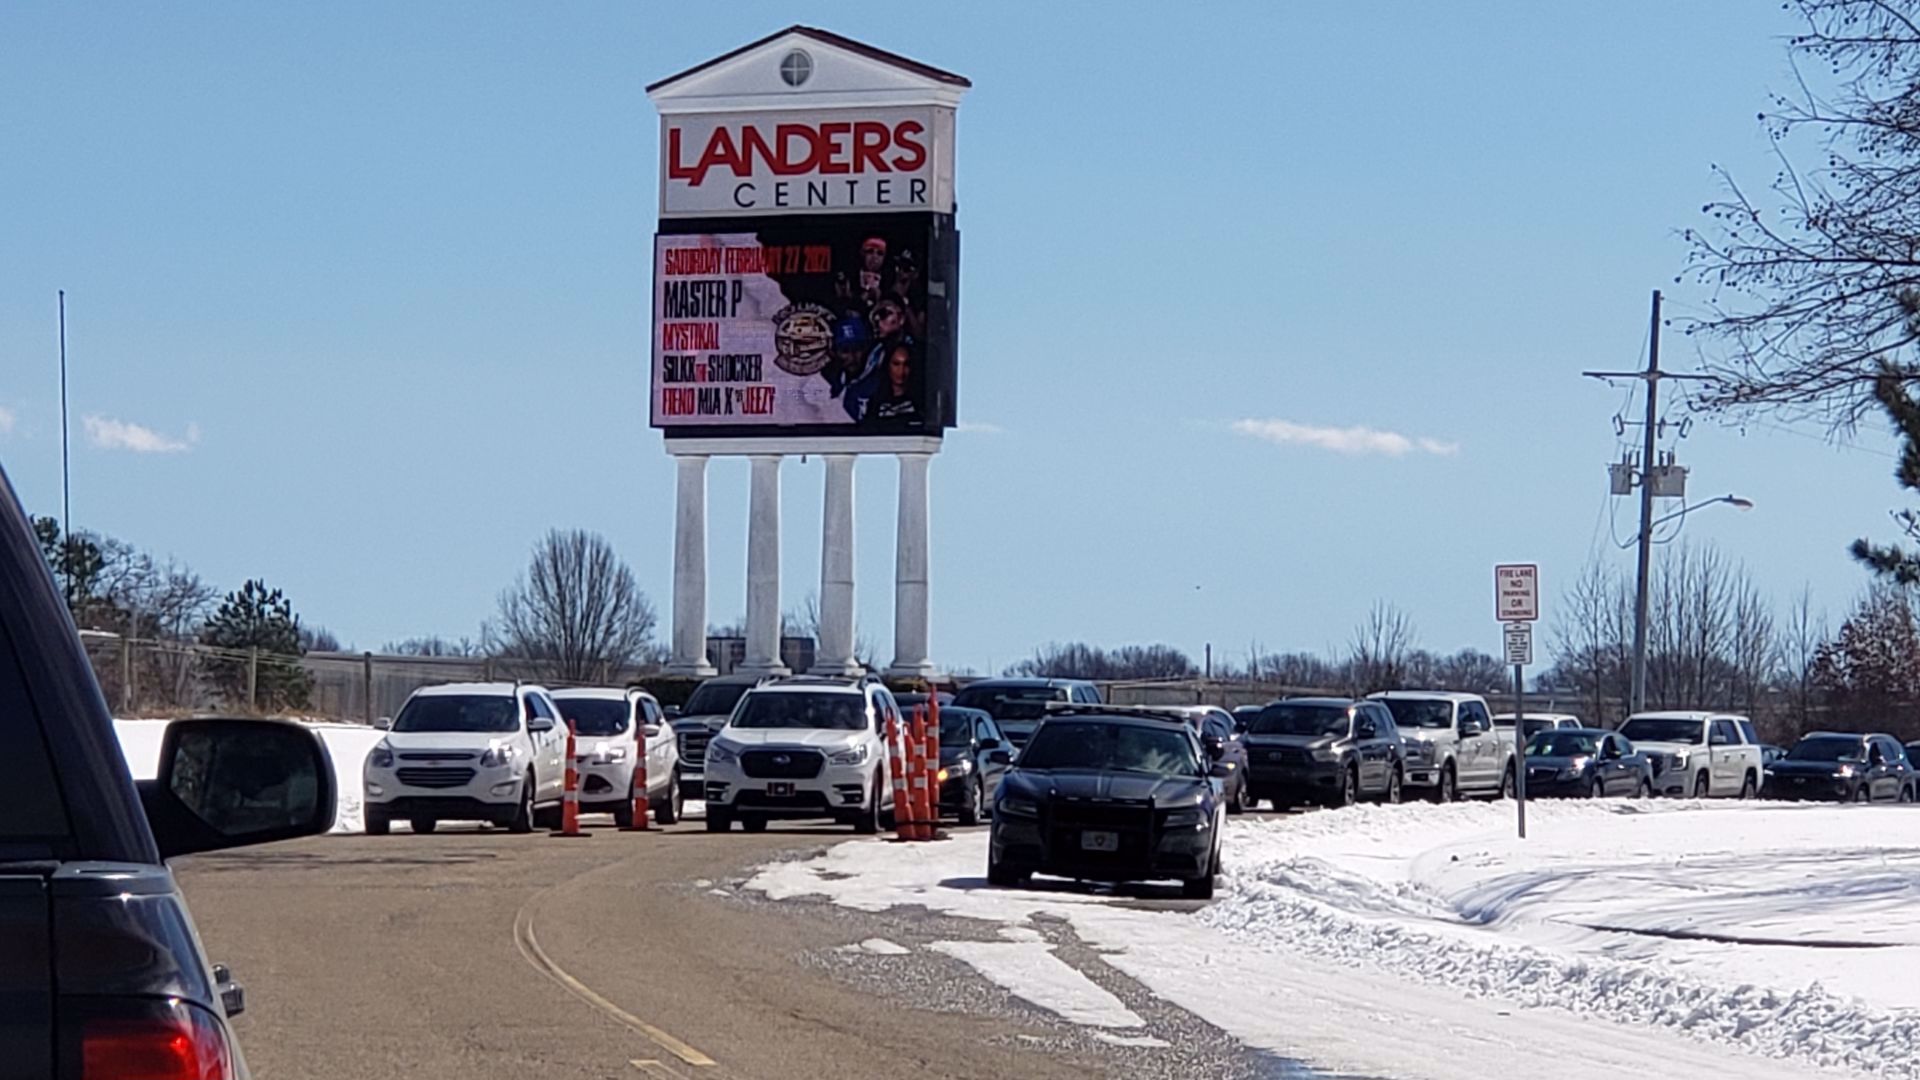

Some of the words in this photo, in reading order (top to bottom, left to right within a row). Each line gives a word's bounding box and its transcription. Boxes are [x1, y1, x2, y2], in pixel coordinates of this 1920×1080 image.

[668, 121, 927, 186] LANDERS
[733, 178, 927, 208] CENTER
[664, 247, 722, 275] SATURDAY
[725, 246, 781, 274] FEBRUARY
[784, 246, 800, 273] 27
[804, 245, 831, 273] 2021
[663, 280, 727, 319] MASTER
[731, 279, 743, 317] P
[662, 322, 720, 351] MYSTIKAL
[662, 355, 696, 383] SILKK
[708, 353, 763, 382] SHOCKER
[662, 387, 695, 416] FIEND
[697, 386, 721, 416] MIA
[724, 386, 734, 416] X
[742, 386, 776, 415] JEEZY
[1510, 579, 1523, 588] NO
[1511, 599, 1523, 607] OR
